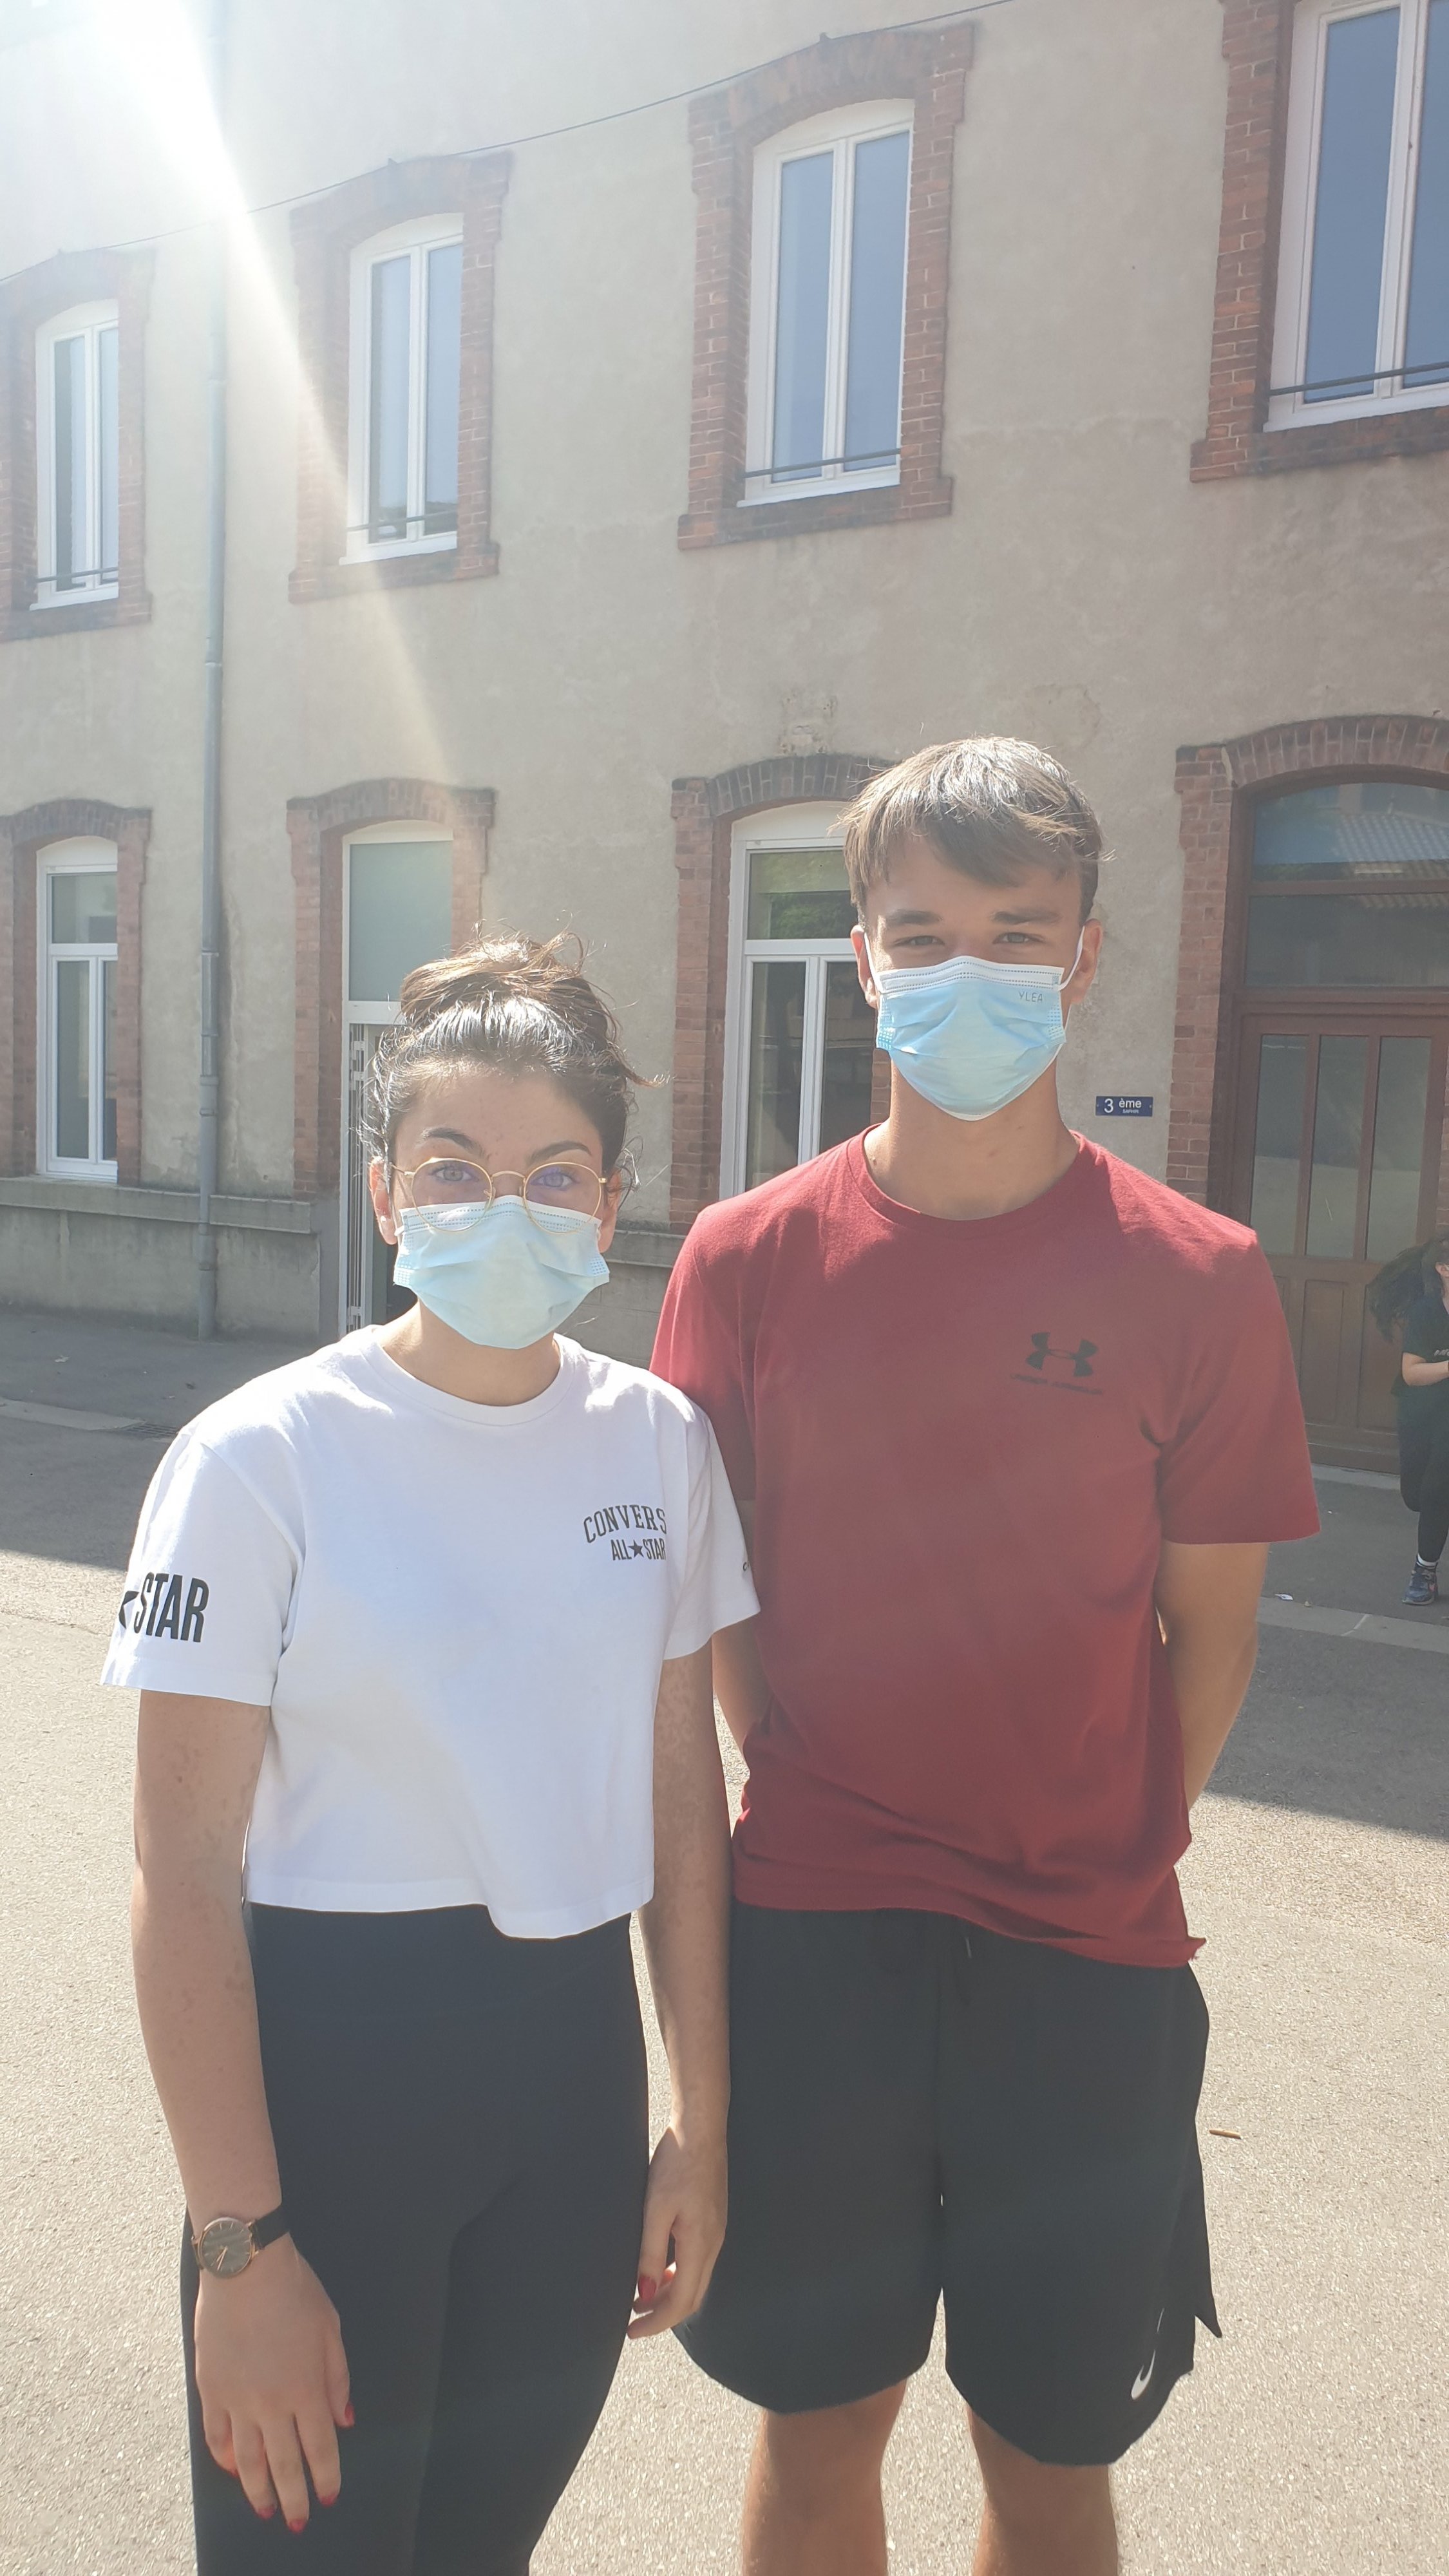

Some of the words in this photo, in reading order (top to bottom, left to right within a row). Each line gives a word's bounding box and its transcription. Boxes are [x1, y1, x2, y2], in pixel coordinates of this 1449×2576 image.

[1104, 1098, 1113, 1113] 3
[1119, 1097, 1142, 1108] ème
[611, 1539, 632, 1561] ALL
[642, 1538, 666, 1560] STAR
[133, 1572, 209, 1643] STAR
